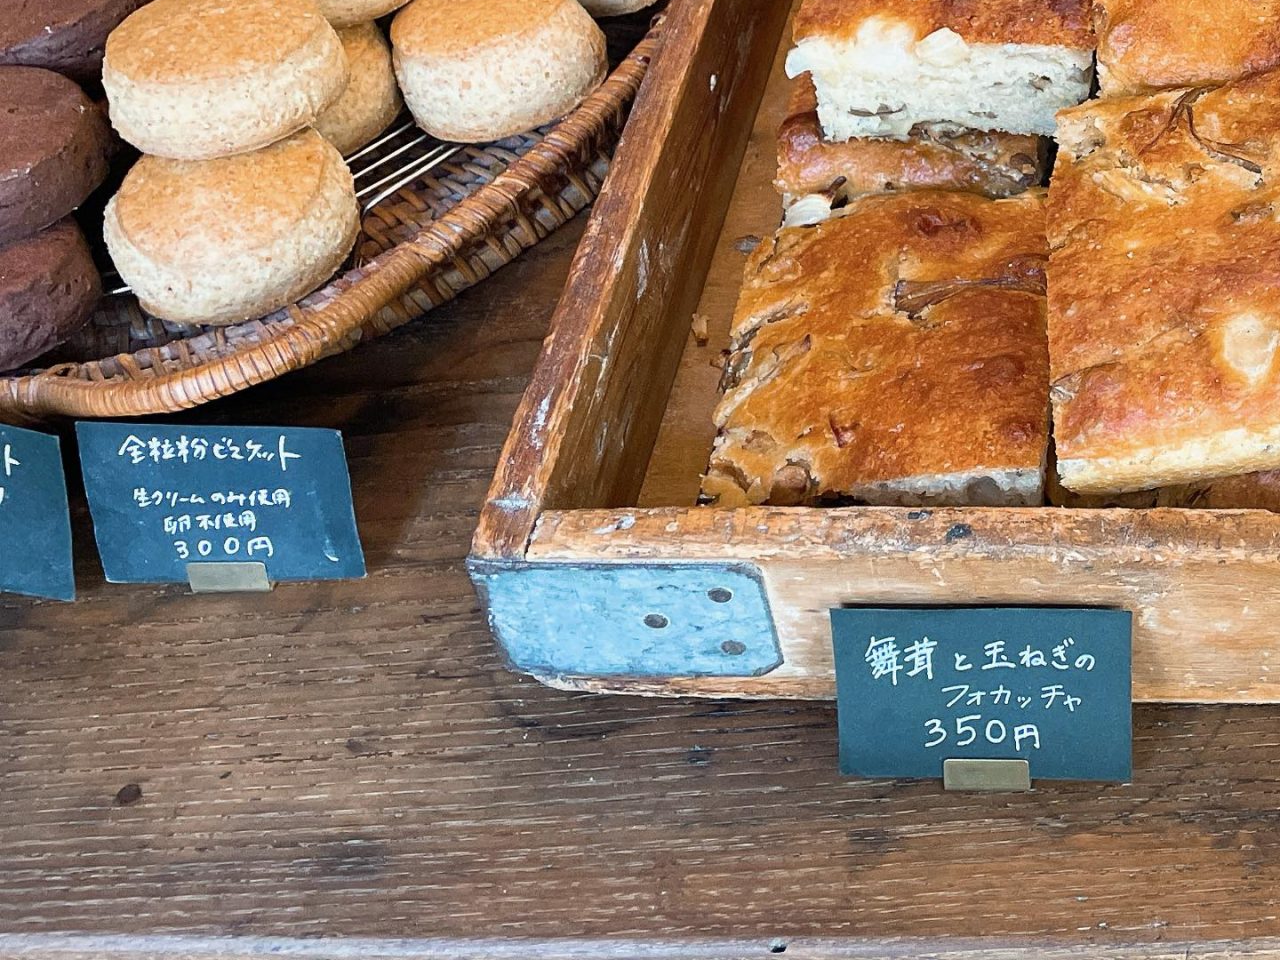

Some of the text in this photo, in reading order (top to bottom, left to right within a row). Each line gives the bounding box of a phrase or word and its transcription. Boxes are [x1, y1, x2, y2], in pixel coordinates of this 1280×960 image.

[118, 434, 301, 471] 全粒粉ビスケット
[133, 487, 292, 509] 生クリームのみ使用
[163, 510, 258, 535] 卵不使用
[174, 536, 274, 559] 300円
[941, 684, 1083, 713] フォカッチャ
[923, 714, 1041, 751] 350円
